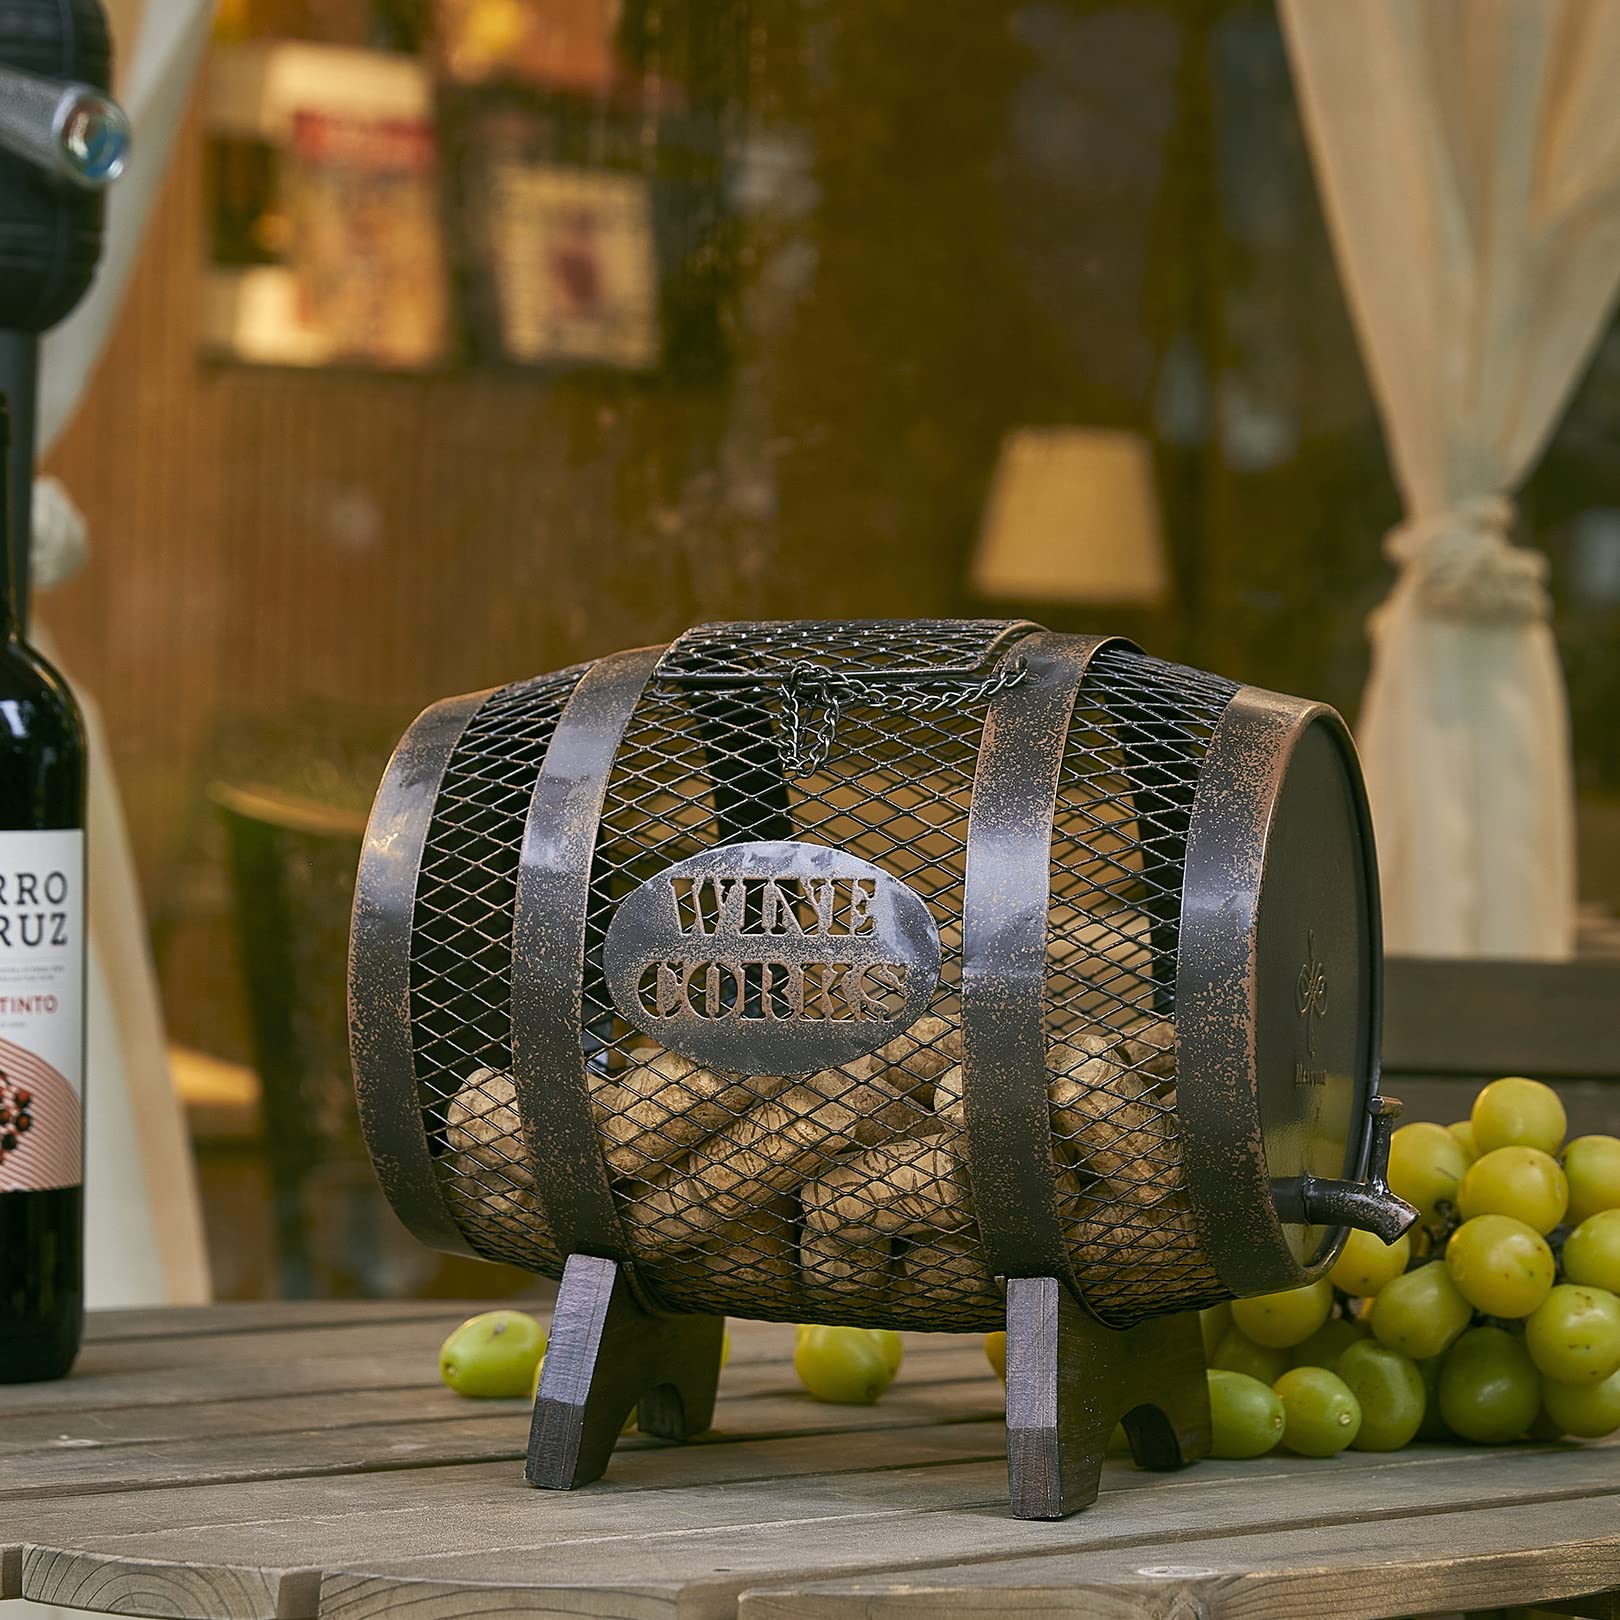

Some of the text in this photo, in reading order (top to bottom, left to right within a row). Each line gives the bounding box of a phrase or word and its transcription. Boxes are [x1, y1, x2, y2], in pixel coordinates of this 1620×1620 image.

[670, 878, 876, 937] WINE
[0, 994, 58, 1014] TINTO
[638, 961, 909, 1022] CORKS
